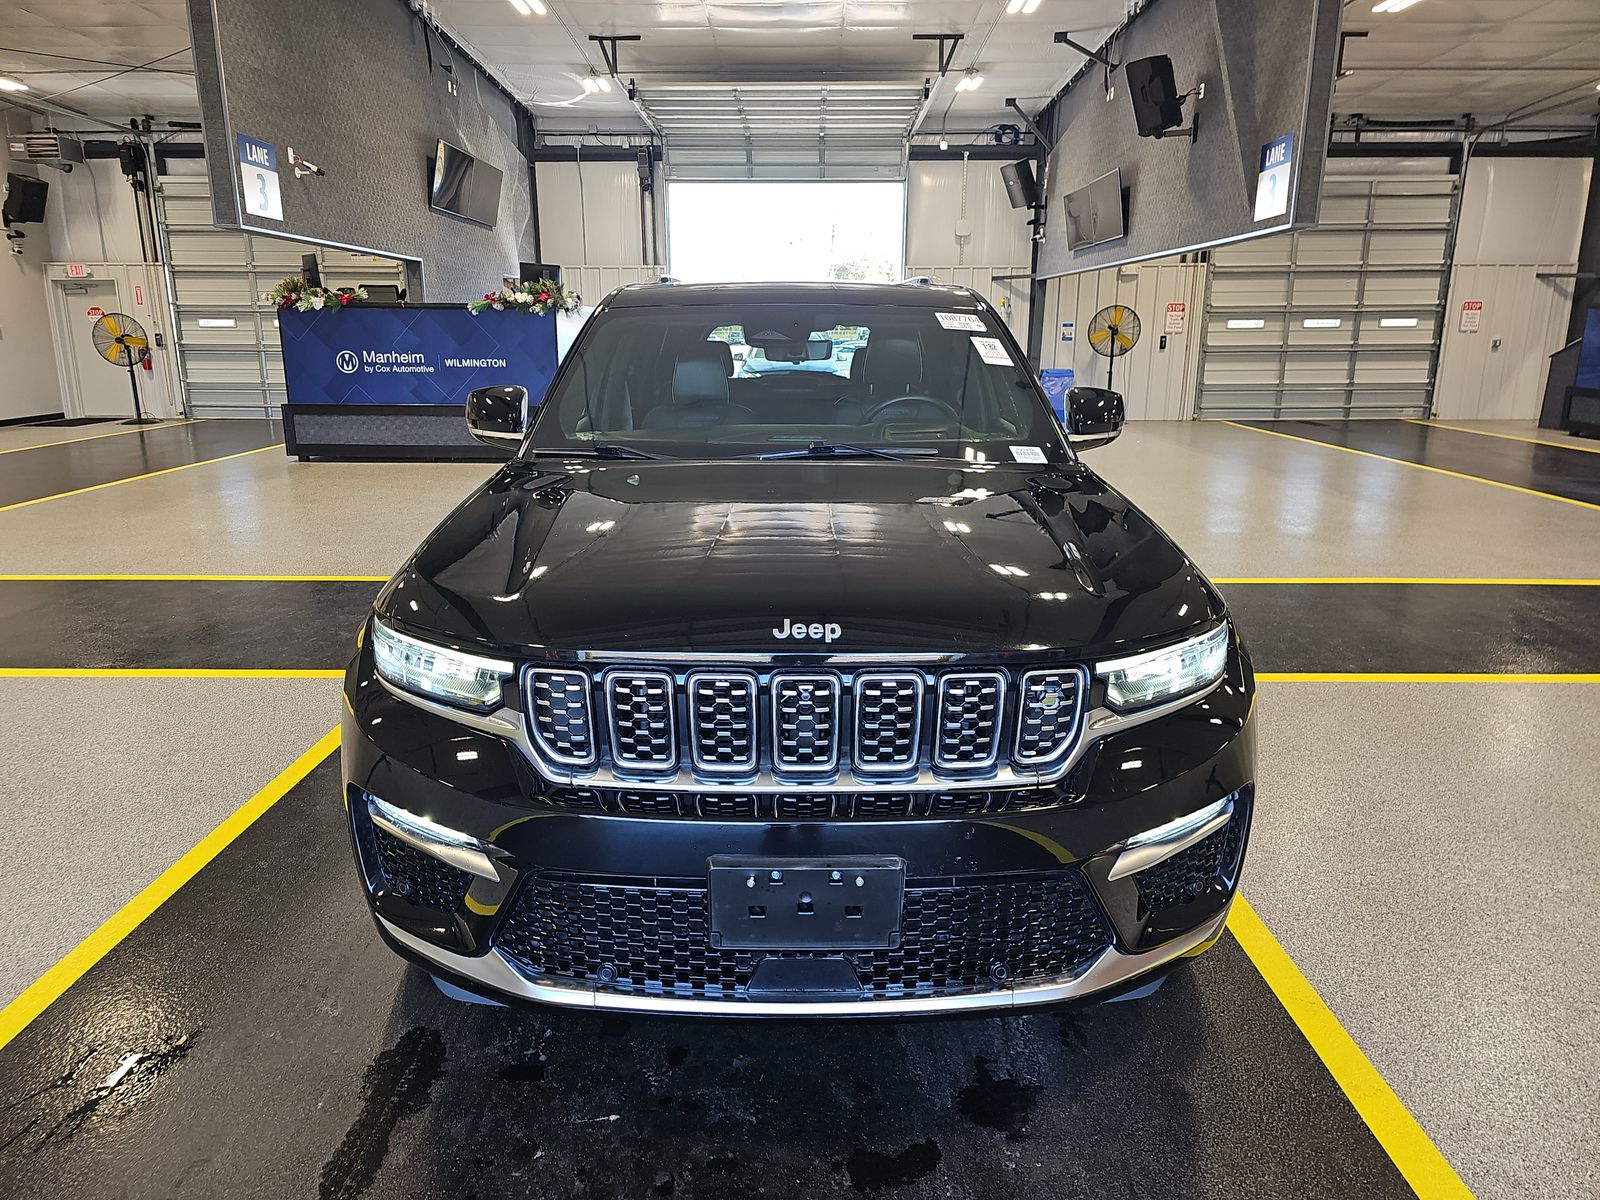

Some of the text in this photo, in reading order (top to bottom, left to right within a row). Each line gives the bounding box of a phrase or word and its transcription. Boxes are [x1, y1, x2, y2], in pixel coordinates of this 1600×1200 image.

[246, 142, 269, 166] LANE
[1265, 142, 1286, 167] LANE
[256, 173, 268, 211] 3
[1464, 302, 1482, 310] STOP
[363, 350, 425, 363] Manheim
[444, 358, 507, 368] WILMINGTON
[364, 364, 434, 373] by Cox Automotive
[772, 618, 842, 643] Jeep
